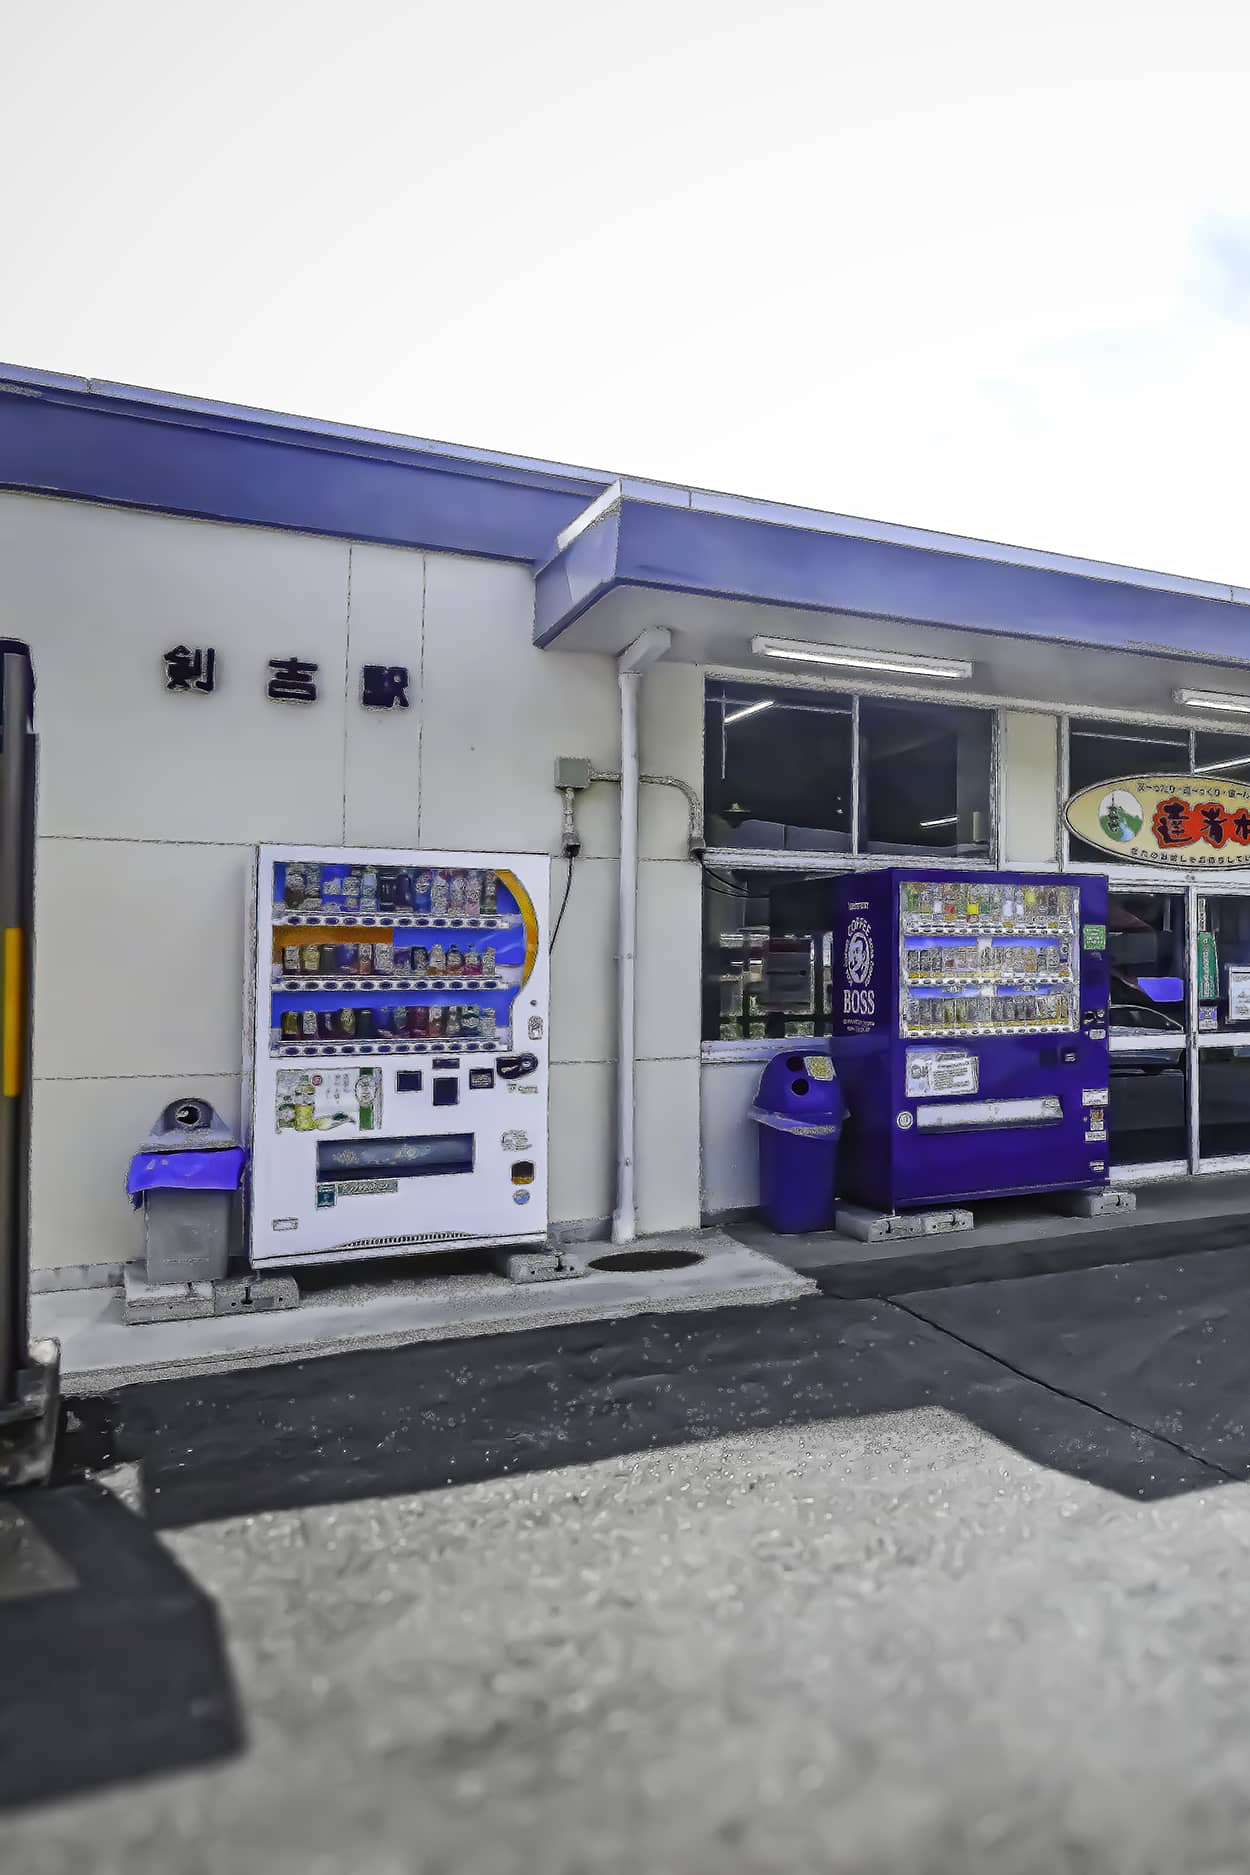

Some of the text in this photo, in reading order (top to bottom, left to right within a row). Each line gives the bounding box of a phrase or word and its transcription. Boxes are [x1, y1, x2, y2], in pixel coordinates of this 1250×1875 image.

[163, 645, 410, 708] 剣吉駅
[843, 990, 875, 1014] BOSS
